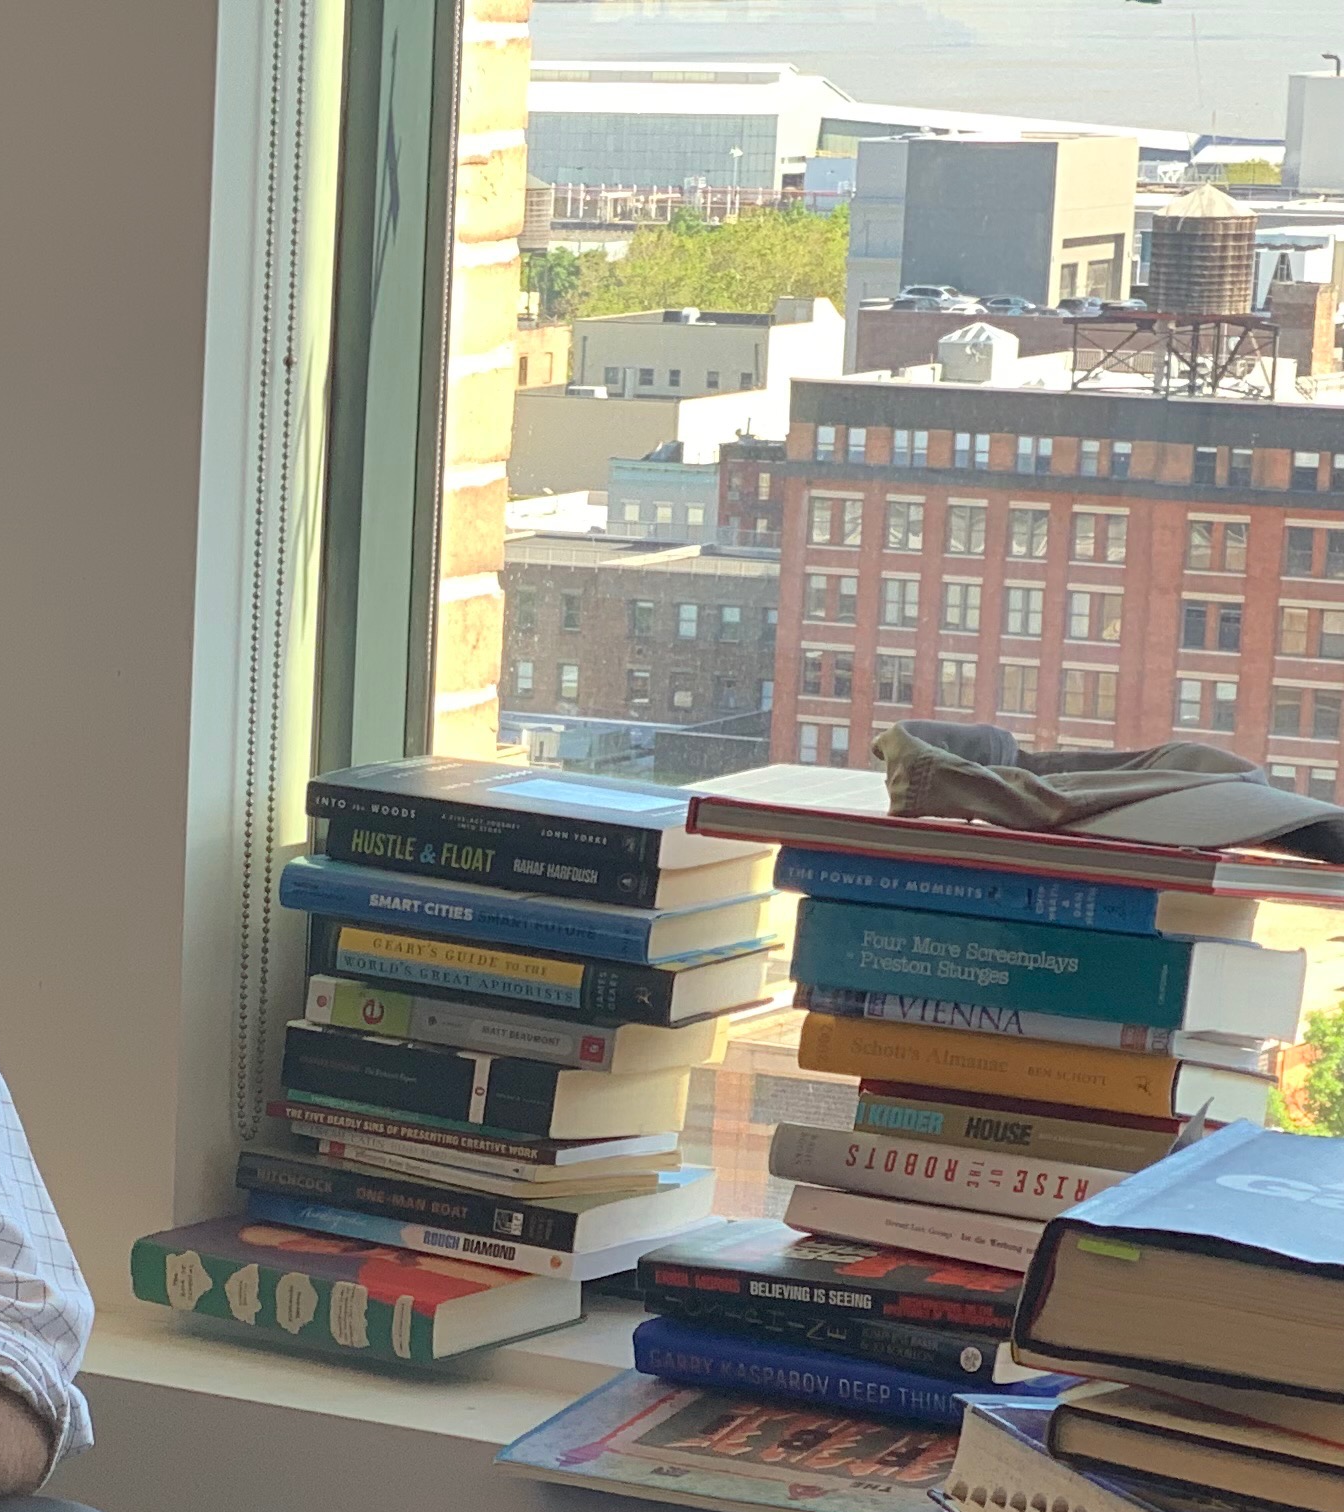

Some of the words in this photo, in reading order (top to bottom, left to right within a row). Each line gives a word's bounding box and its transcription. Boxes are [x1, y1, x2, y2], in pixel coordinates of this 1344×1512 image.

[315, 796, 346, 810] INTO
[371, 803, 417, 819] WOODS
[351, 828, 416, 863] HUSTLE
[420, 845, 436, 865] &
[440, 842, 496, 873] FLOAT
[541, 828, 569, 841] JOHN
[573, 832, 607, 846] YORKE
[513, 856, 546, 877] RAHAF
[546, 862, 599, 885] HARFOUSH
[789, 866, 815, 882] THE
[819, 870, 873, 887] POWER
[880, 876, 899, 890] OF
[906, 880, 983, 900] MOMENTS
[369, 893, 420, 914] SMART
[424, 901, 473, 922] CITIES
[372, 935, 438, 960] GEARY'S
[445, 947, 498, 969] GUIDE
[860, 952, 932, 978] Preston
[936, 960, 1010, 986] Sturges
[862, 931, 907, 953] Four
[912, 936, 961, 958] More
[965, 942, 1079, 974] Screenplays
[343, 954, 412, 978] WORLD'S
[420, 967, 471, 987] GREAT
[478, 976, 574, 1003] APHORISTS
[897, 995, 1025, 1035] VIENNA
[286, 1107, 304, 1120] THE
[304, 1111, 325, 1125] FIVE
[327, 1115, 361, 1130] DEADLY
[363, 1119, 385, 1133] SINS
[387, 1124, 398, 1135] OF
[401, 1127, 459, 1146] PRESENTING
[461, 1137, 506, 1153] CREATIVE
[509, 1144, 538, 1159] WORK
[965, 1116, 1033, 1146] HOUSE
[845, 1143, 959, 1183] ROBOTS
[257, 1168, 333, 1194] HITCHCOCK
[1013, 1169, 1090, 1201] RISE
[423, 1229, 460, 1250] ROUGH
[463, 1238, 516, 1261] DIAMOND
[750, 1281, 810, 1303] BELIEVING
[813, 1288, 826, 1303] IS
[828, 1290, 873, 1310] SEEING
[649, 1348, 713, 1375] GARRY
[721, 1359, 829, 1395] KASPAROV
[839, 1377, 891, 1404] DEEP
